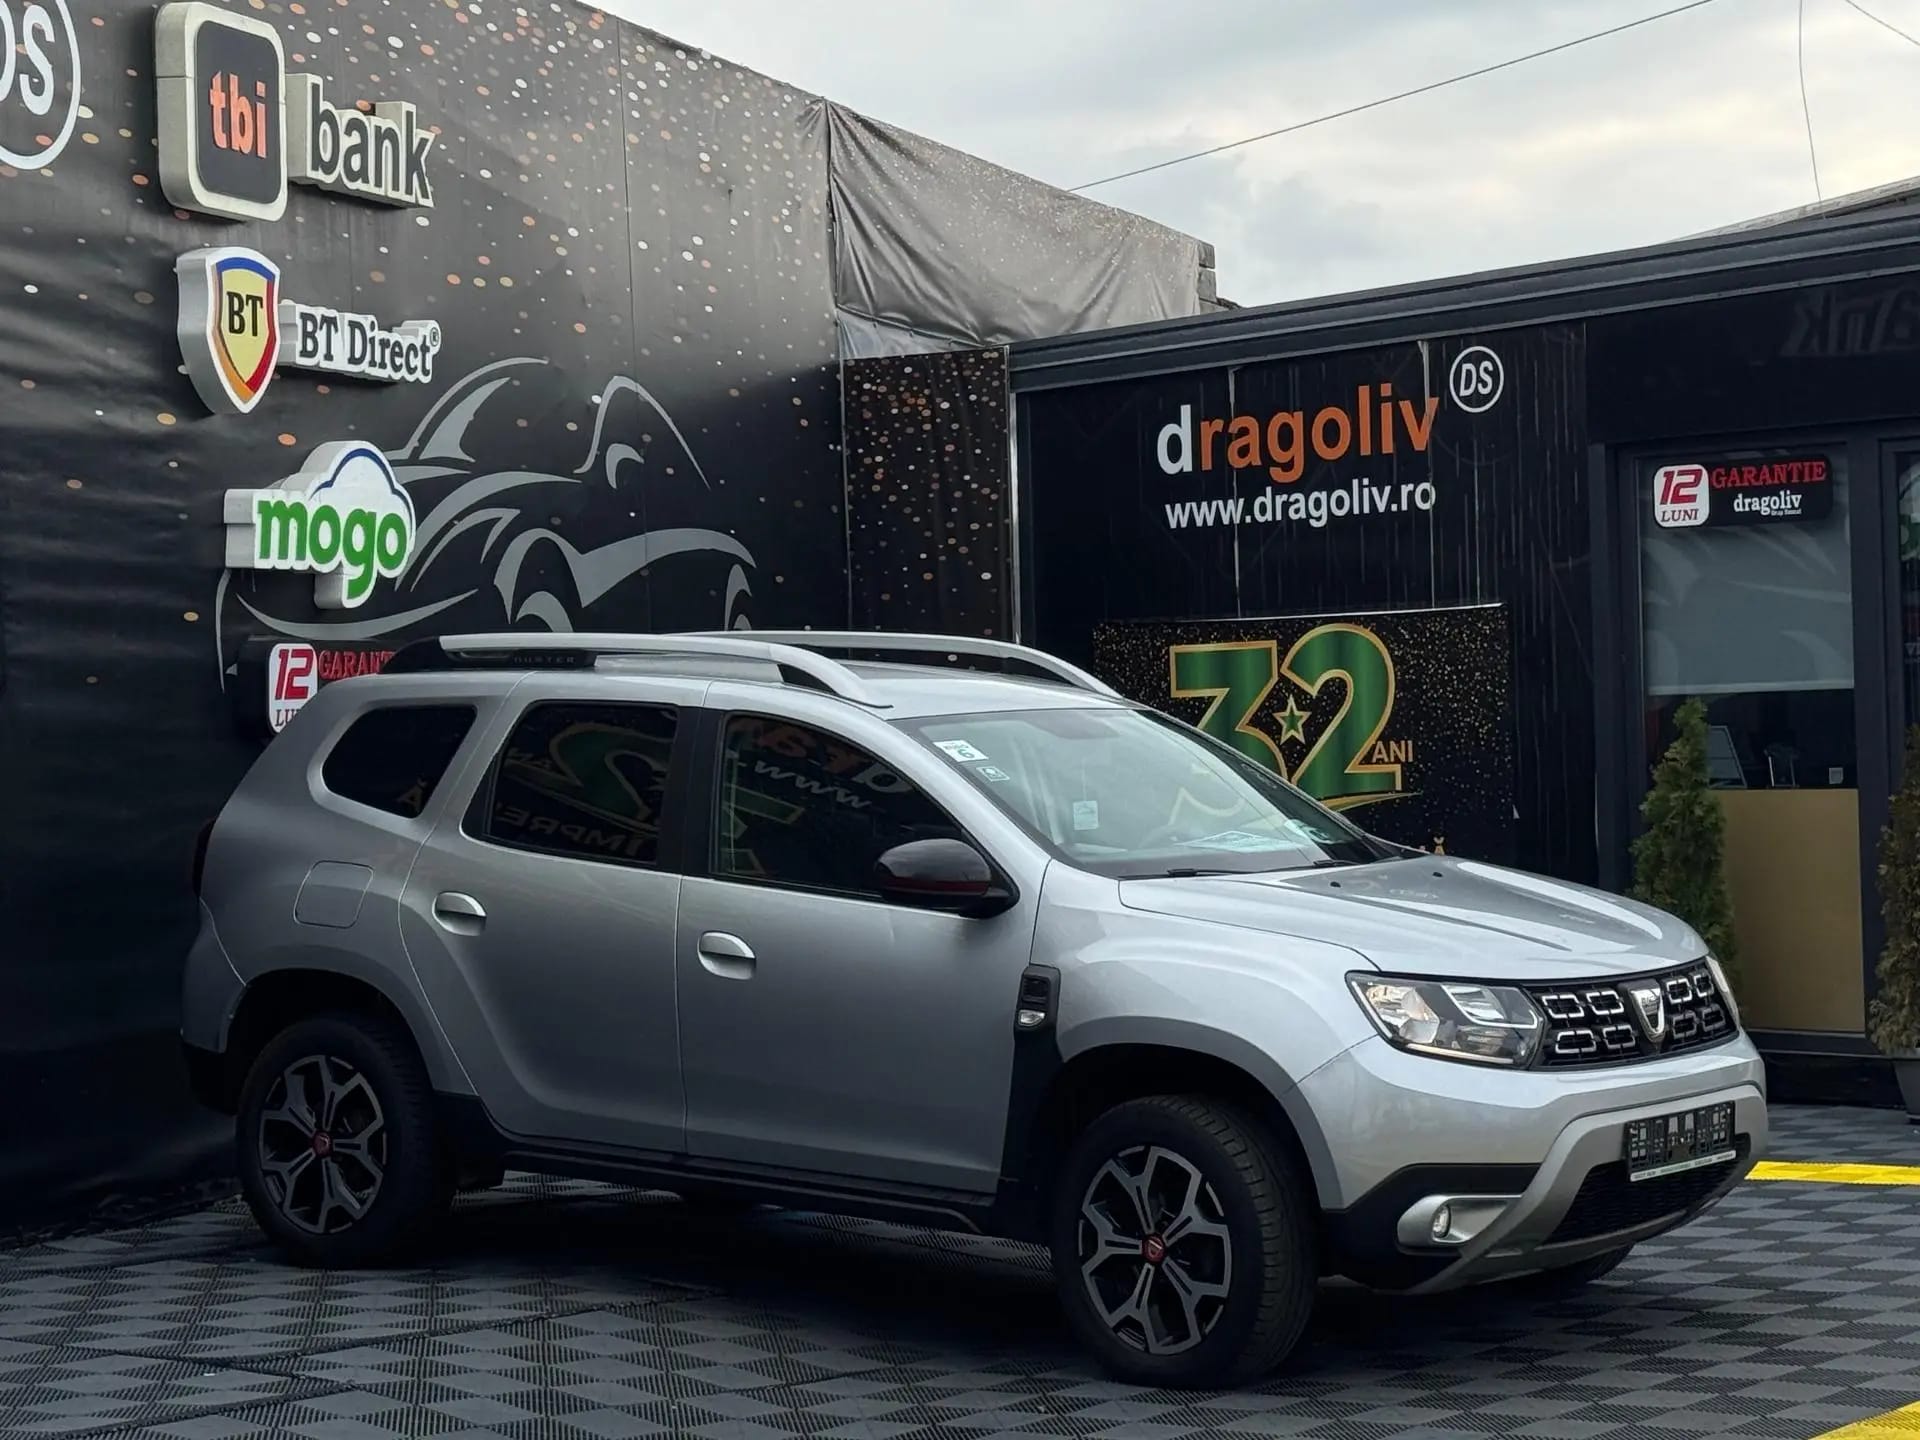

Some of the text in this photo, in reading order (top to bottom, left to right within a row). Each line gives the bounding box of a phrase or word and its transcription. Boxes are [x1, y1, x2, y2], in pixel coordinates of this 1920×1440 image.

[209, 71, 267, 158] tbi
[311, 82, 432, 203] bank
[226, 291, 263, 337] BT
[299, 312, 338, 361] BT
[1459, 359, 1494, 397] DS
[1157, 383, 1440, 483] dragoliv
[1660, 468, 1704, 506] 12
[1711, 461, 1827, 489] GARANTIE
[1165, 477, 1437, 529] www.dragoliv.ro
[1661, 508, 1699, 522] LUNI
[1733, 490, 1802, 516] dragoliv
[257, 498, 408, 600] mogo
[274, 648, 314, 701] 12
[1170, 623, 1414, 798] 32 ANI
